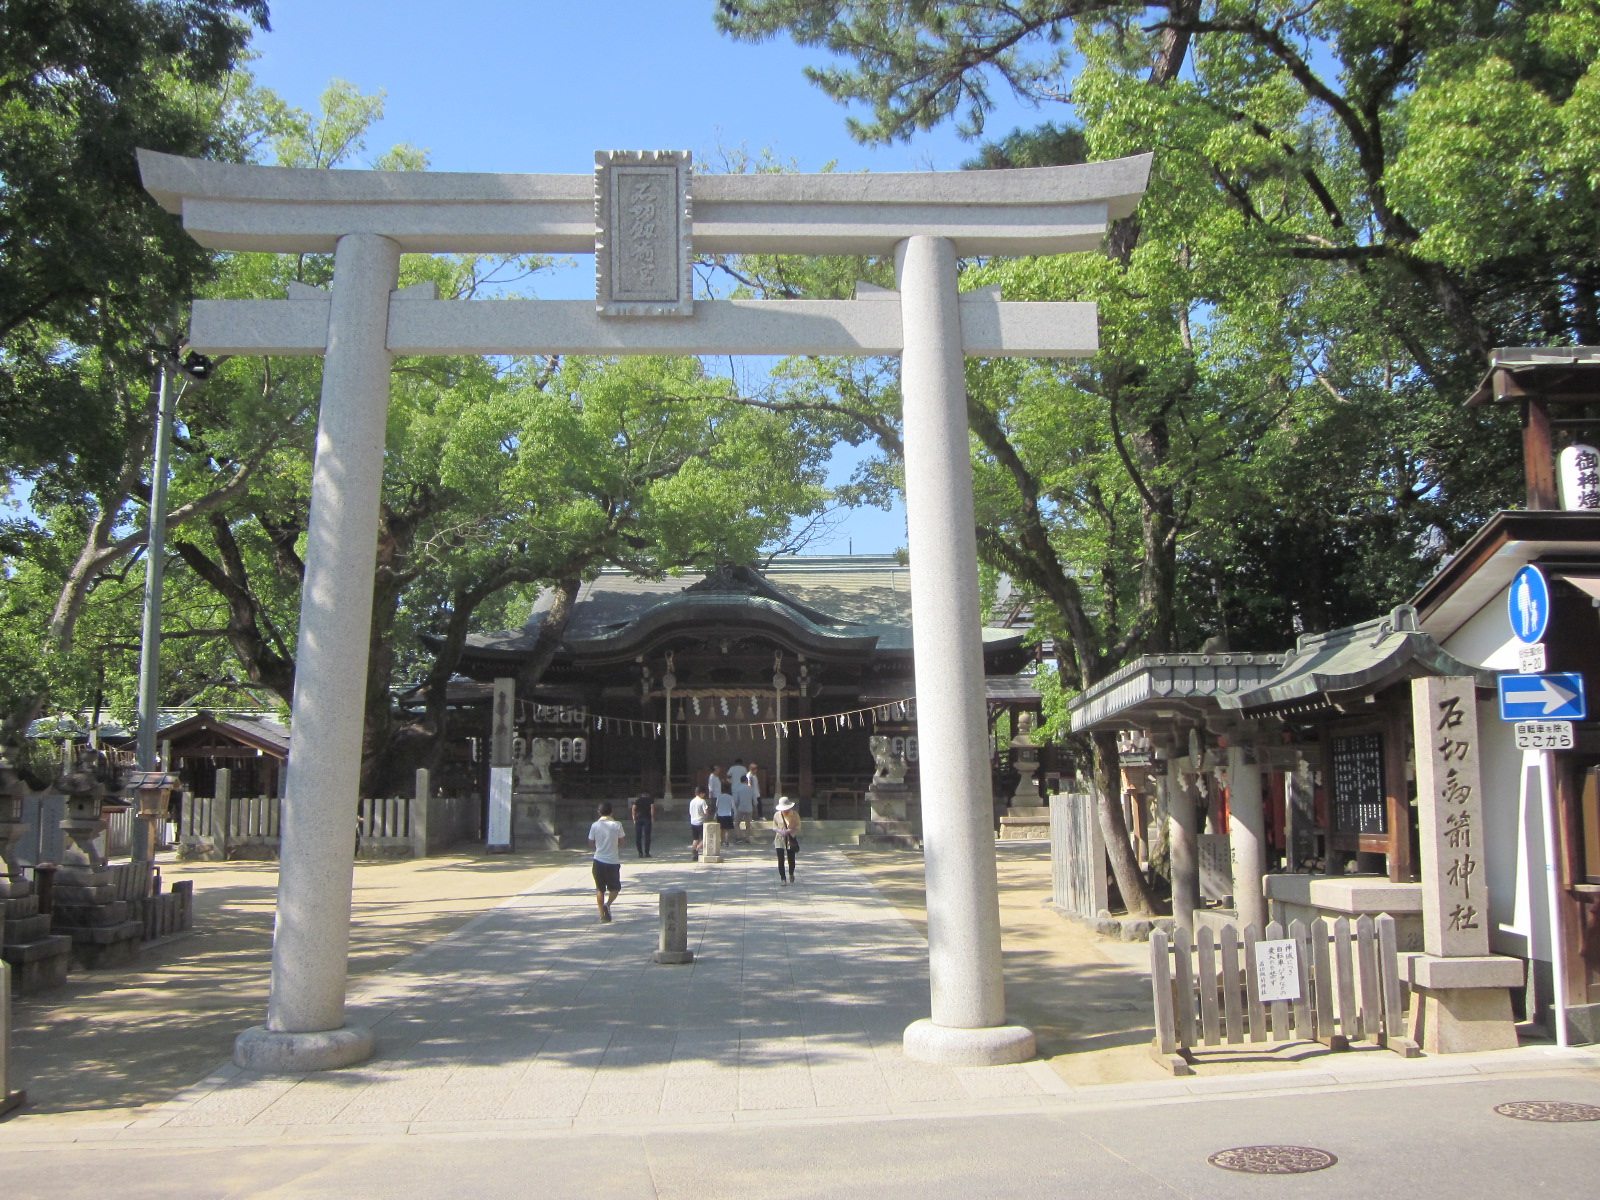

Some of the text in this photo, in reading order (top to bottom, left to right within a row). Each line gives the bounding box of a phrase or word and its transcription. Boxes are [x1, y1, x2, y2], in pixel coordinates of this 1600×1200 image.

[1518, 724, 1570, 734] 自転車を除く
[1519, 734, 1571, 748] ここから
